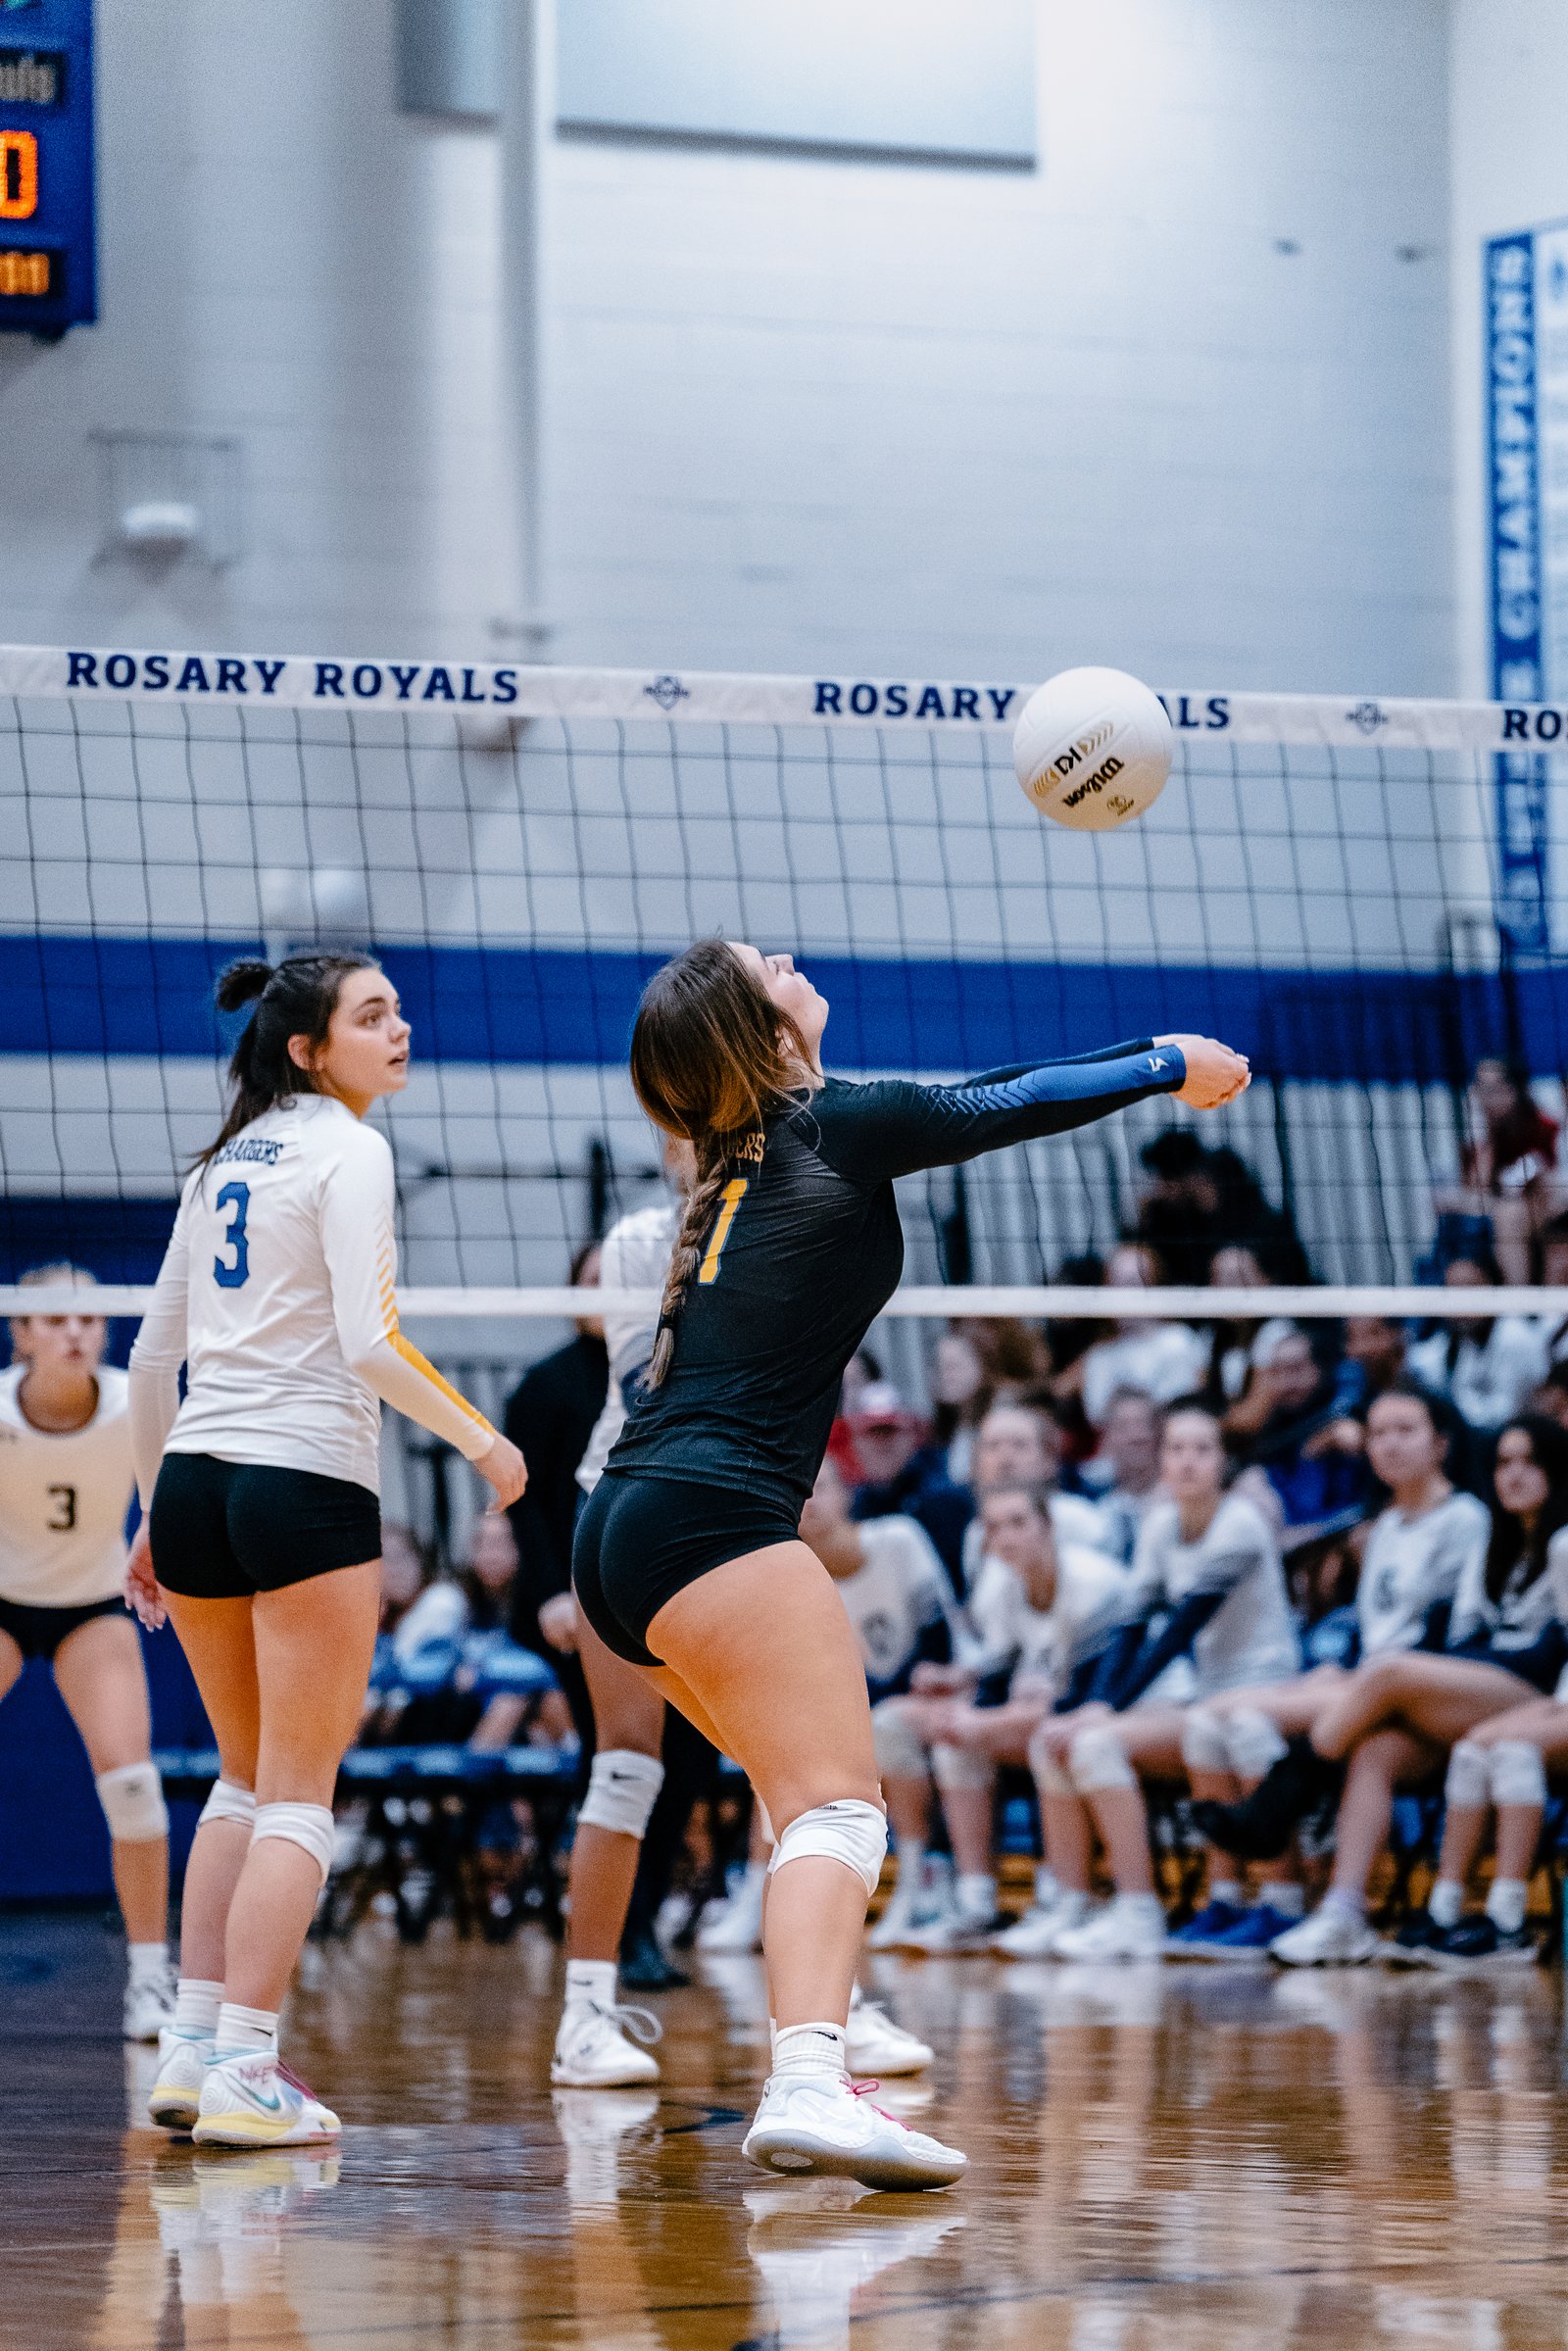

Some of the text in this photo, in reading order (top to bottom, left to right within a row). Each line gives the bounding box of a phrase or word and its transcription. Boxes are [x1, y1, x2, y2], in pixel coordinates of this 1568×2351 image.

[67, 652, 517, 703] ROSARY ROYALS
[814, 682, 1229, 729] ROSARY LS
[1062, 758, 1124, 808] Wilson
[213, 1182, 251, 1289] 3
[47, 1485, 76, 1532] 3
